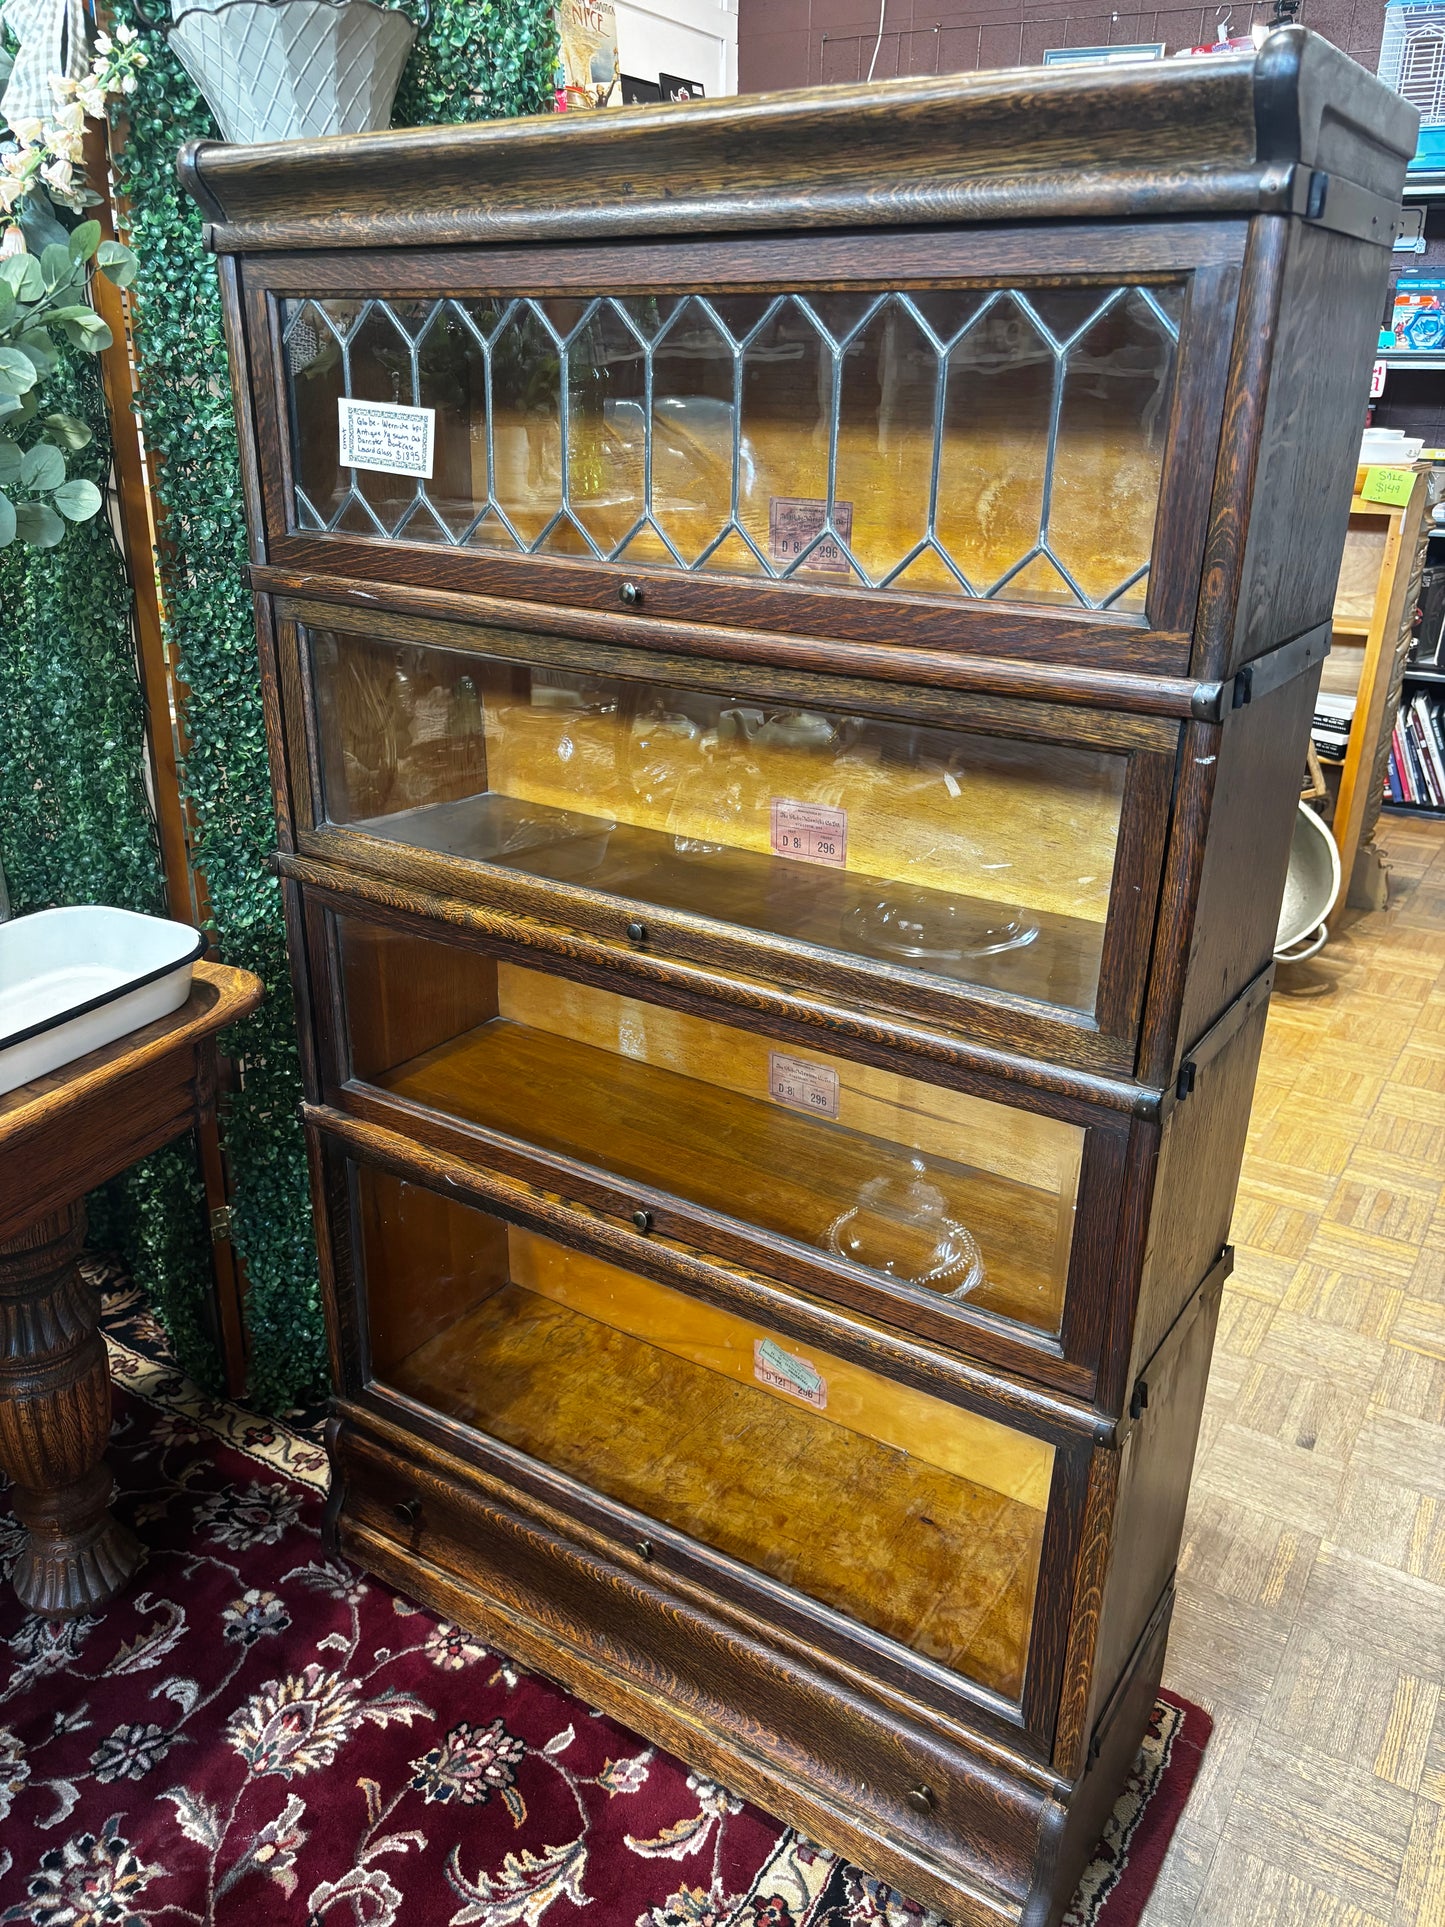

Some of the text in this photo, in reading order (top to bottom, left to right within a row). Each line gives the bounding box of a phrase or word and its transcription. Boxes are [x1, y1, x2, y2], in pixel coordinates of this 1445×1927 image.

[572, 5, 610, 37] NICE
[376, 448, 392, 457] Glass
[396, 450, 420, 462] $1895
[1379, 471, 1404, 482] SALE
[1376, 483, 1400, 494] $149
[782, 540, 788, 552] D
[819, 545, 838, 559] 296
[782, 835, 788, 847] D
[817, 841, 835, 855] 296
[778, 1083, 784, 1093] D
[810, 1092, 827, 1106] 296
[766, 1372, 772, 1380] D
